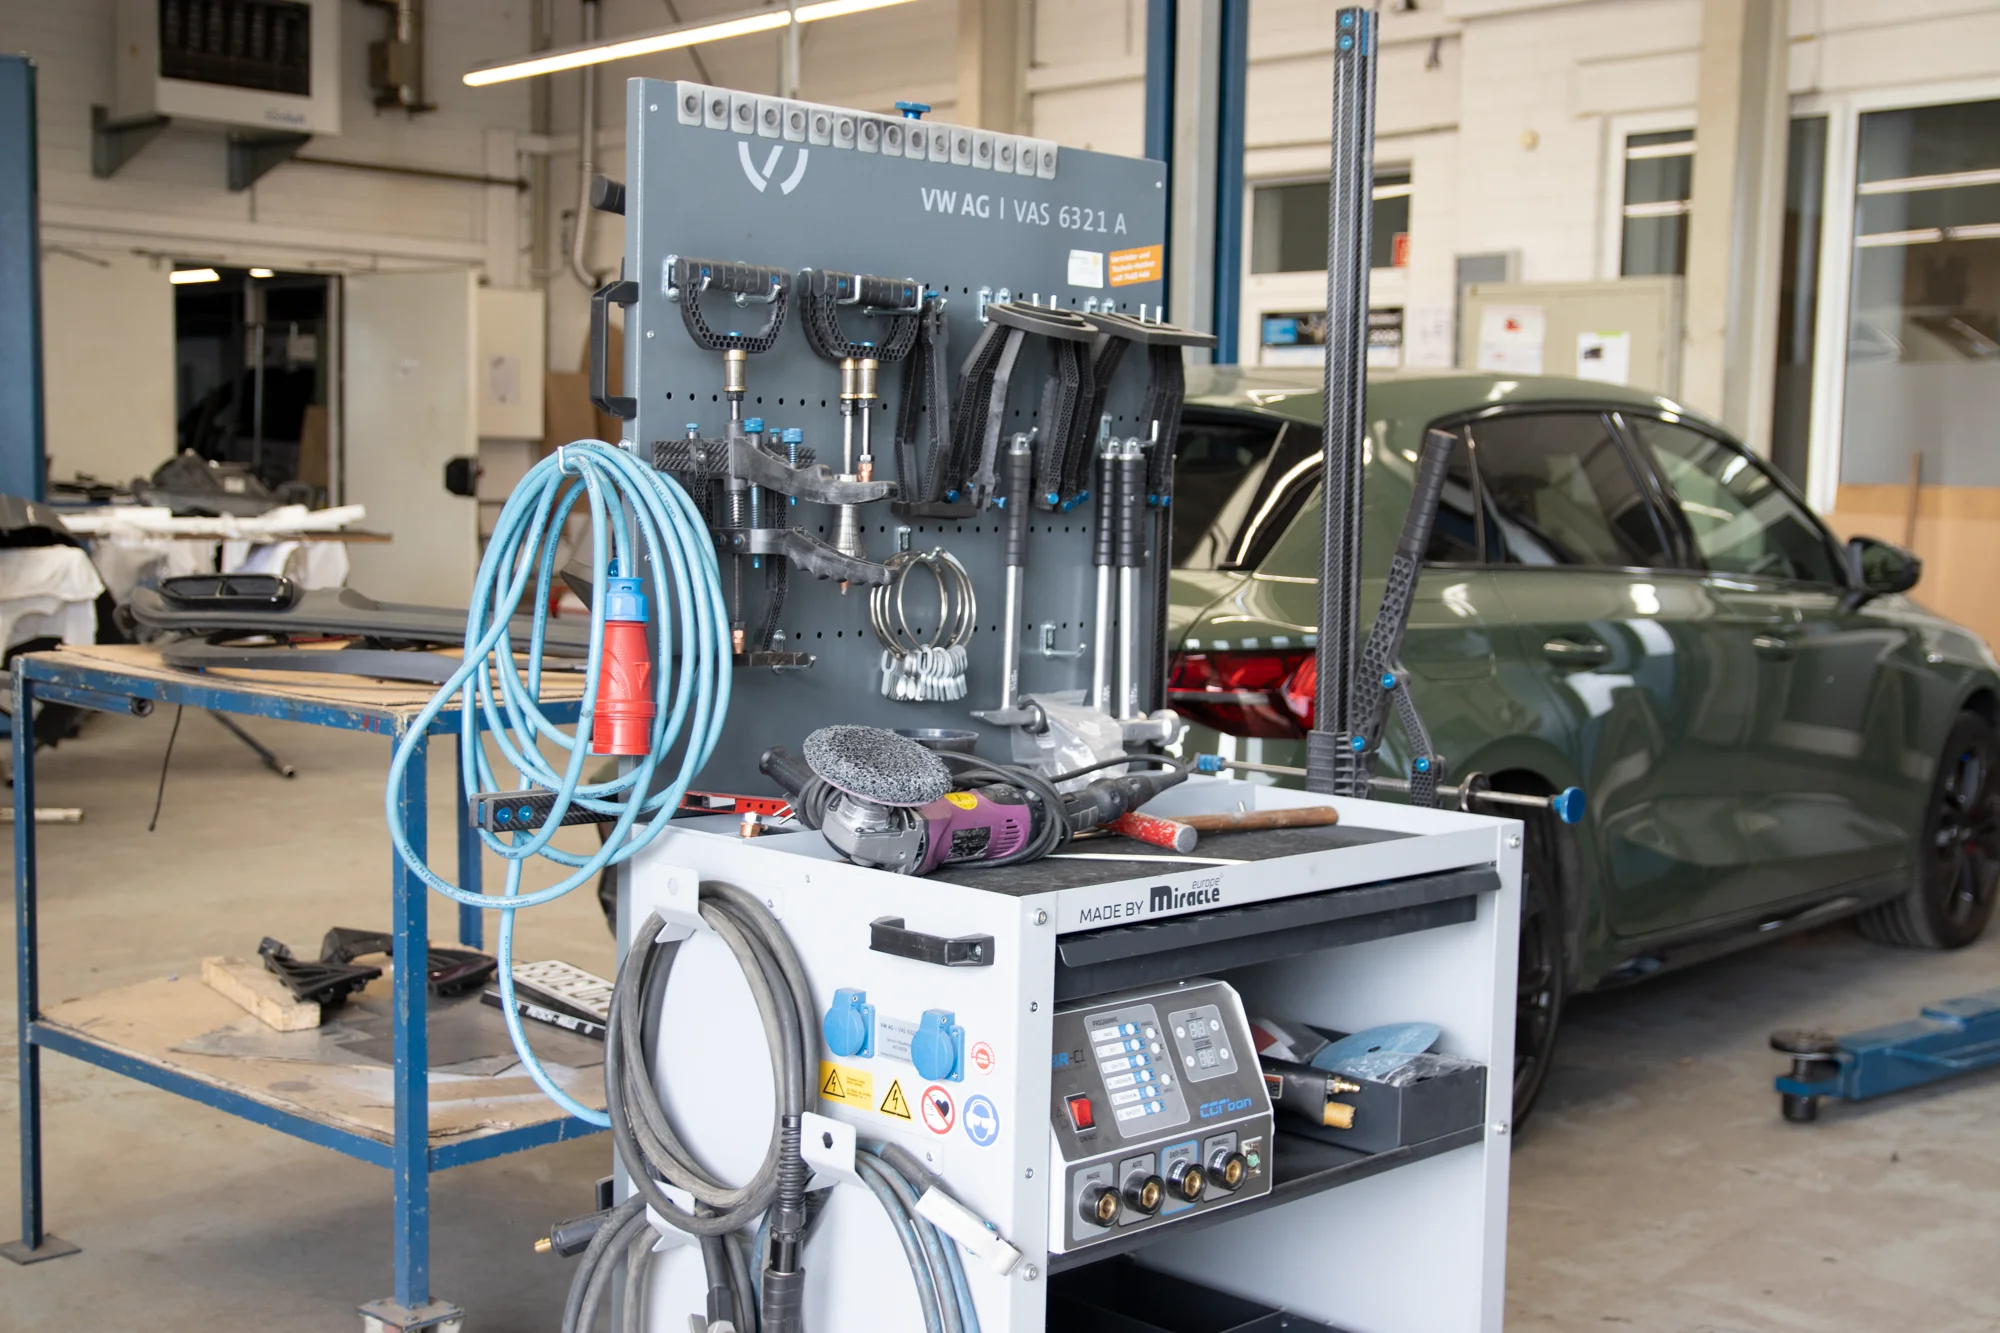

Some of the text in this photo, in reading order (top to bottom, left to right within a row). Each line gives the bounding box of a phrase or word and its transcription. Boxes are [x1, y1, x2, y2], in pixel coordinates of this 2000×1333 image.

[921, 187, 957, 214] VW
[961, 193, 990, 218] AG
[1014, 200, 1050, 225] VAS
[1059, 206, 1107, 232] 6321
[1114, 213, 1127, 235] A
[1192, 876, 1220, 889] europe
[1079, 885, 1220, 924] MADE BY Miracle
[1086, 1171, 1101, 1181] MASSE
